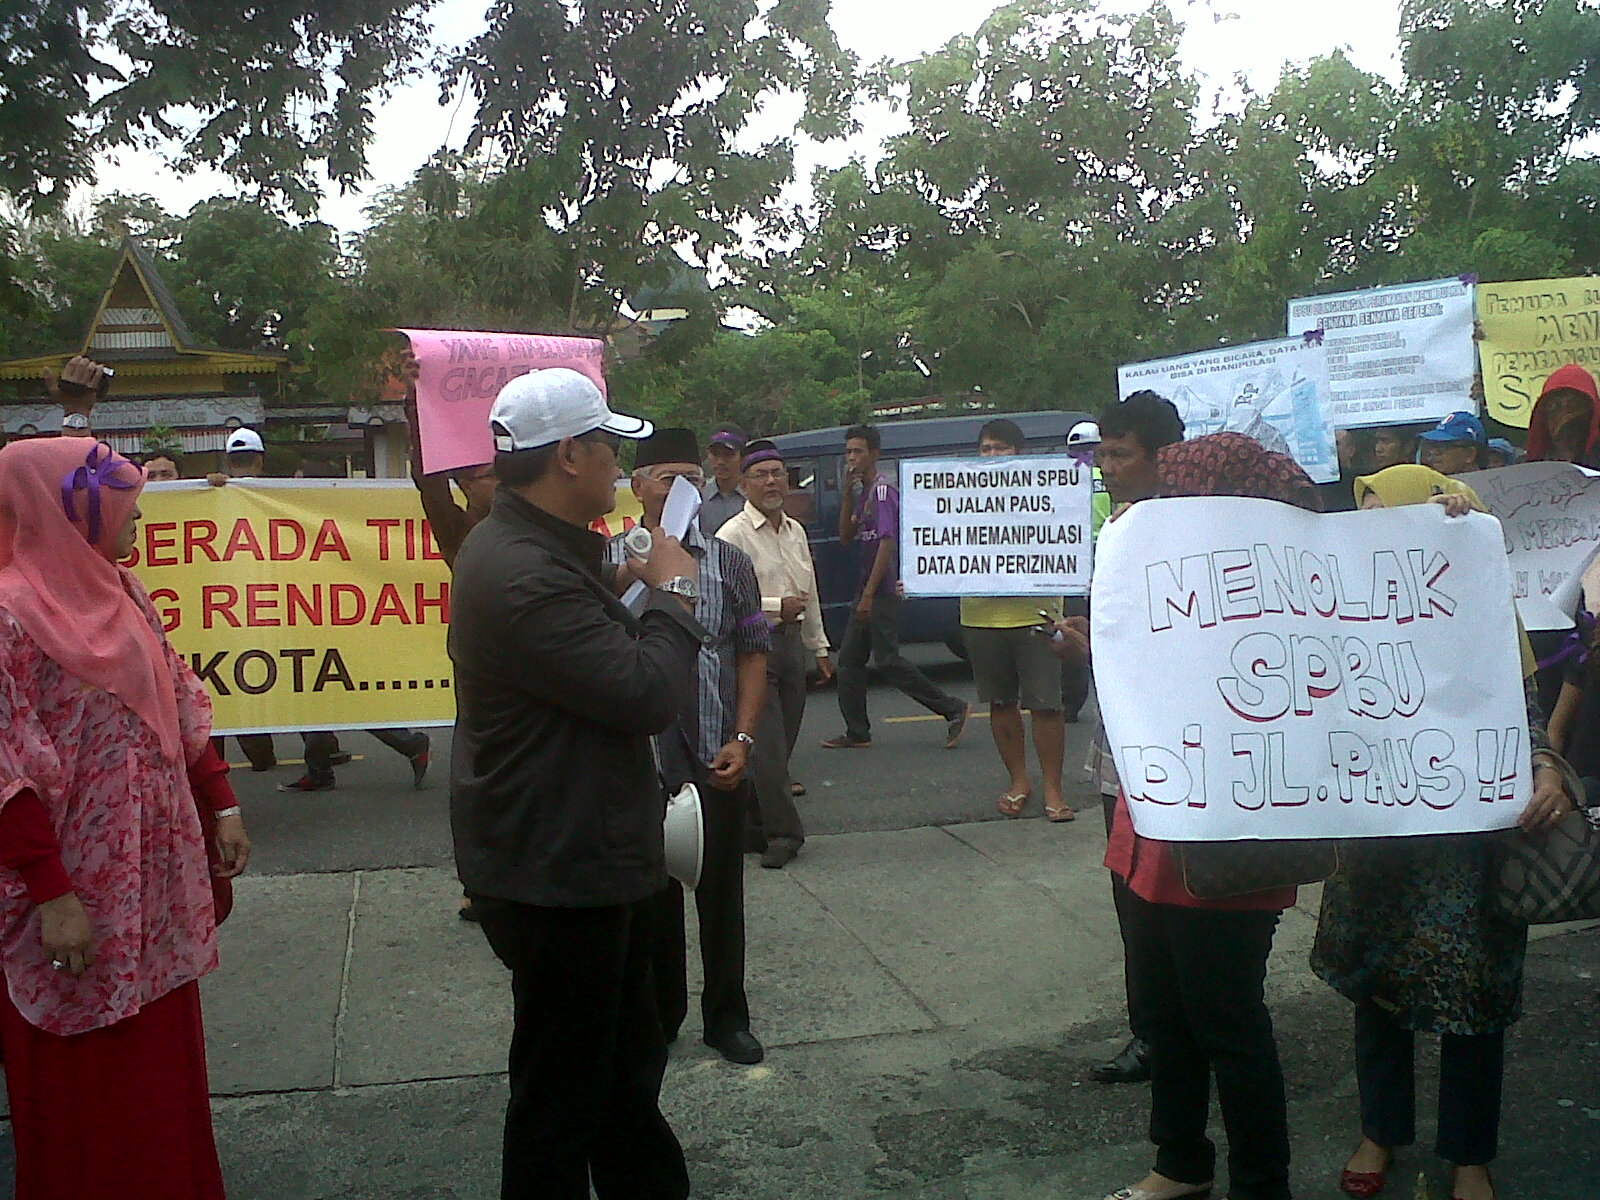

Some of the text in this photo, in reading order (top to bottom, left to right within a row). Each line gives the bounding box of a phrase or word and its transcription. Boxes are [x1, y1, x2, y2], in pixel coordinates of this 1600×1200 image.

[1486, 291, 1567, 314] PEMUDA
[440, 338, 499, 363] YANG
[1161, 362, 1190, 373] UANG
[1191, 357, 1220, 369] YANG
[1268, 344, 1298, 355] DATA
[1170, 356, 1277, 380] BISA DI MANIPULASI
[913, 470, 1032, 490] PEMBANGUNAN
[1037, 469, 1080, 487] SPBU
[936, 495, 1056, 515] DI JALAN PAUS,
[913, 525, 1082, 546] TELAH MEMANIPULASI
[917, 554, 1078, 575] DATA DAN PERIZINAN
[1144, 542, 1458, 633] MENOLAK
[202, 582, 450, 629] RENDAH
[1216, 631, 1426, 723] SPBU
